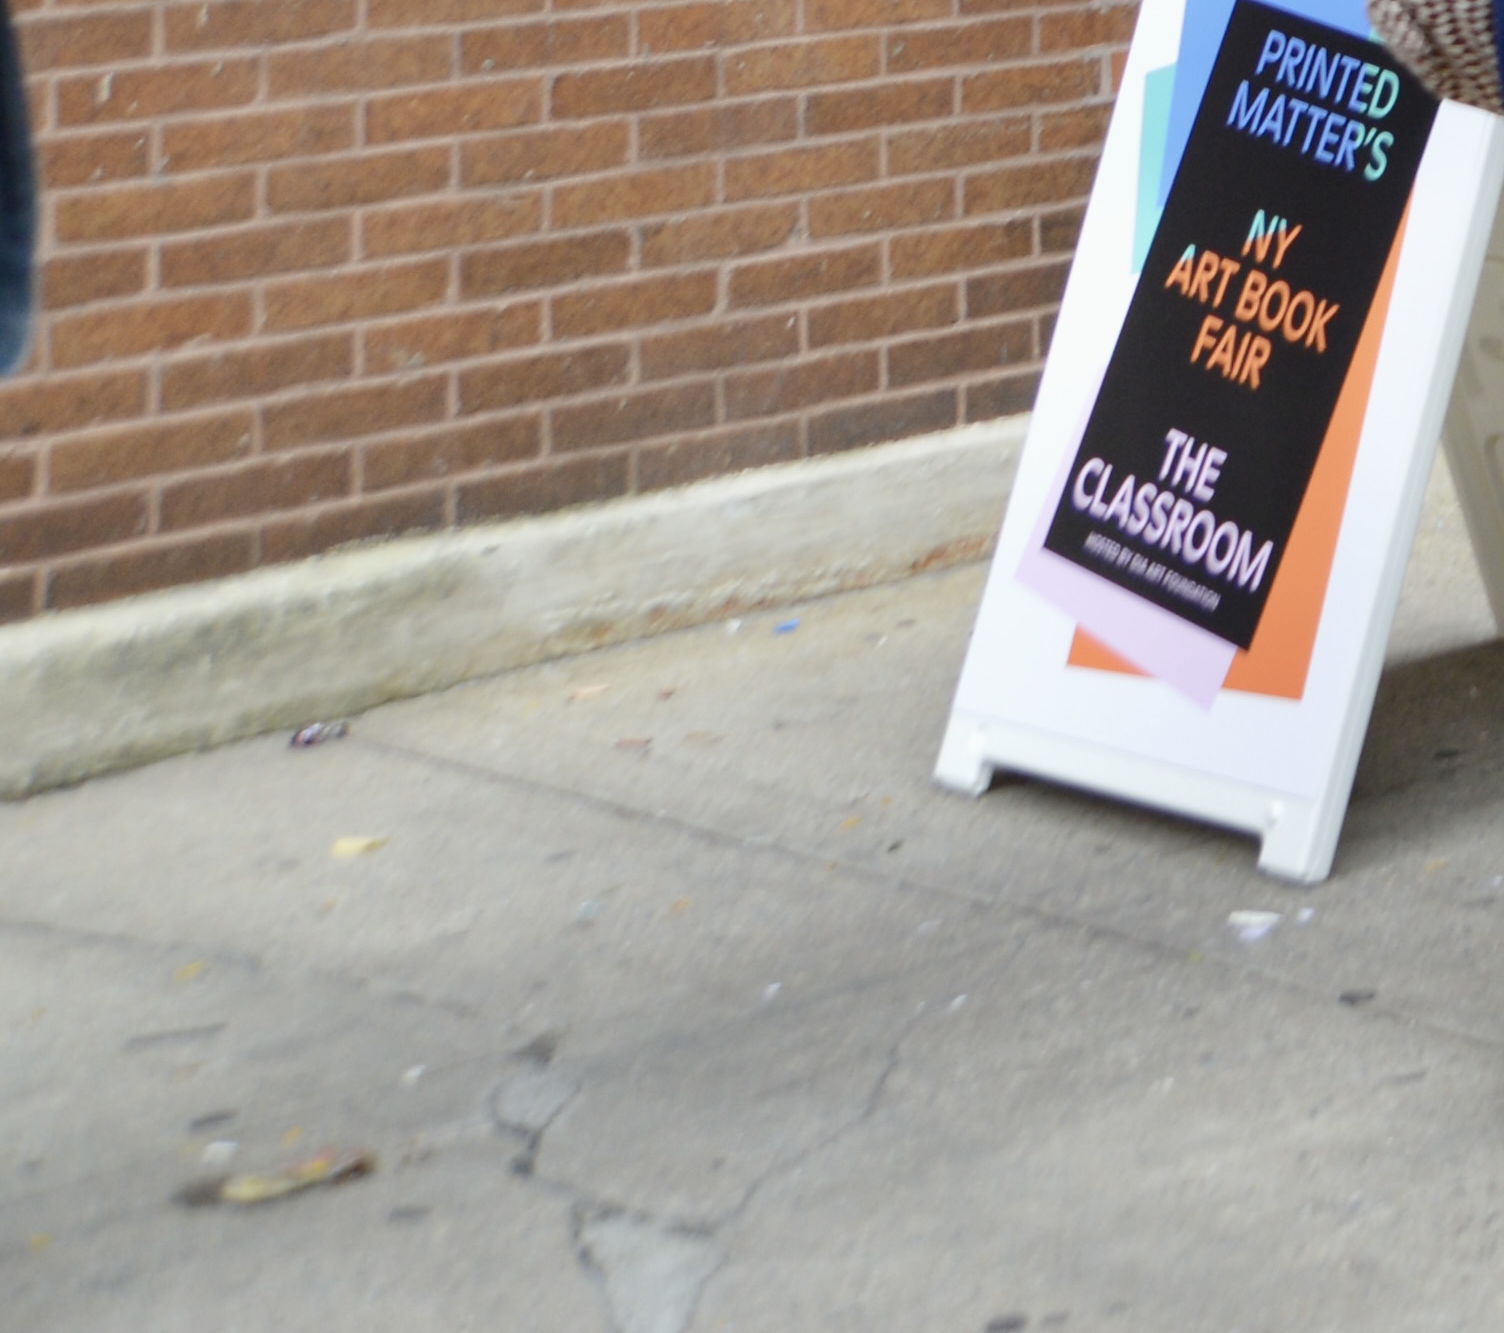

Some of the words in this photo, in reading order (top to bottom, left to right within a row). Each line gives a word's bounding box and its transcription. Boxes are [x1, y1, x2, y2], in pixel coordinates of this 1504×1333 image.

[1255, 29, 1400, 119] PRINTED
[1226, 80, 1394, 181] MATTER'S
[1241, 209, 1302, 269] NY
[1164, 243, 1241, 308] ART
[1234, 269, 1340, 354] BOOK
[1190, 314, 1272, 390] FAIR
[1158, 427, 1228, 502] THE
[1072, 457, 1274, 593] CLASSROOM
[1115, 546, 1134, 567] BY
[1145, 561, 1167, 585] ART
